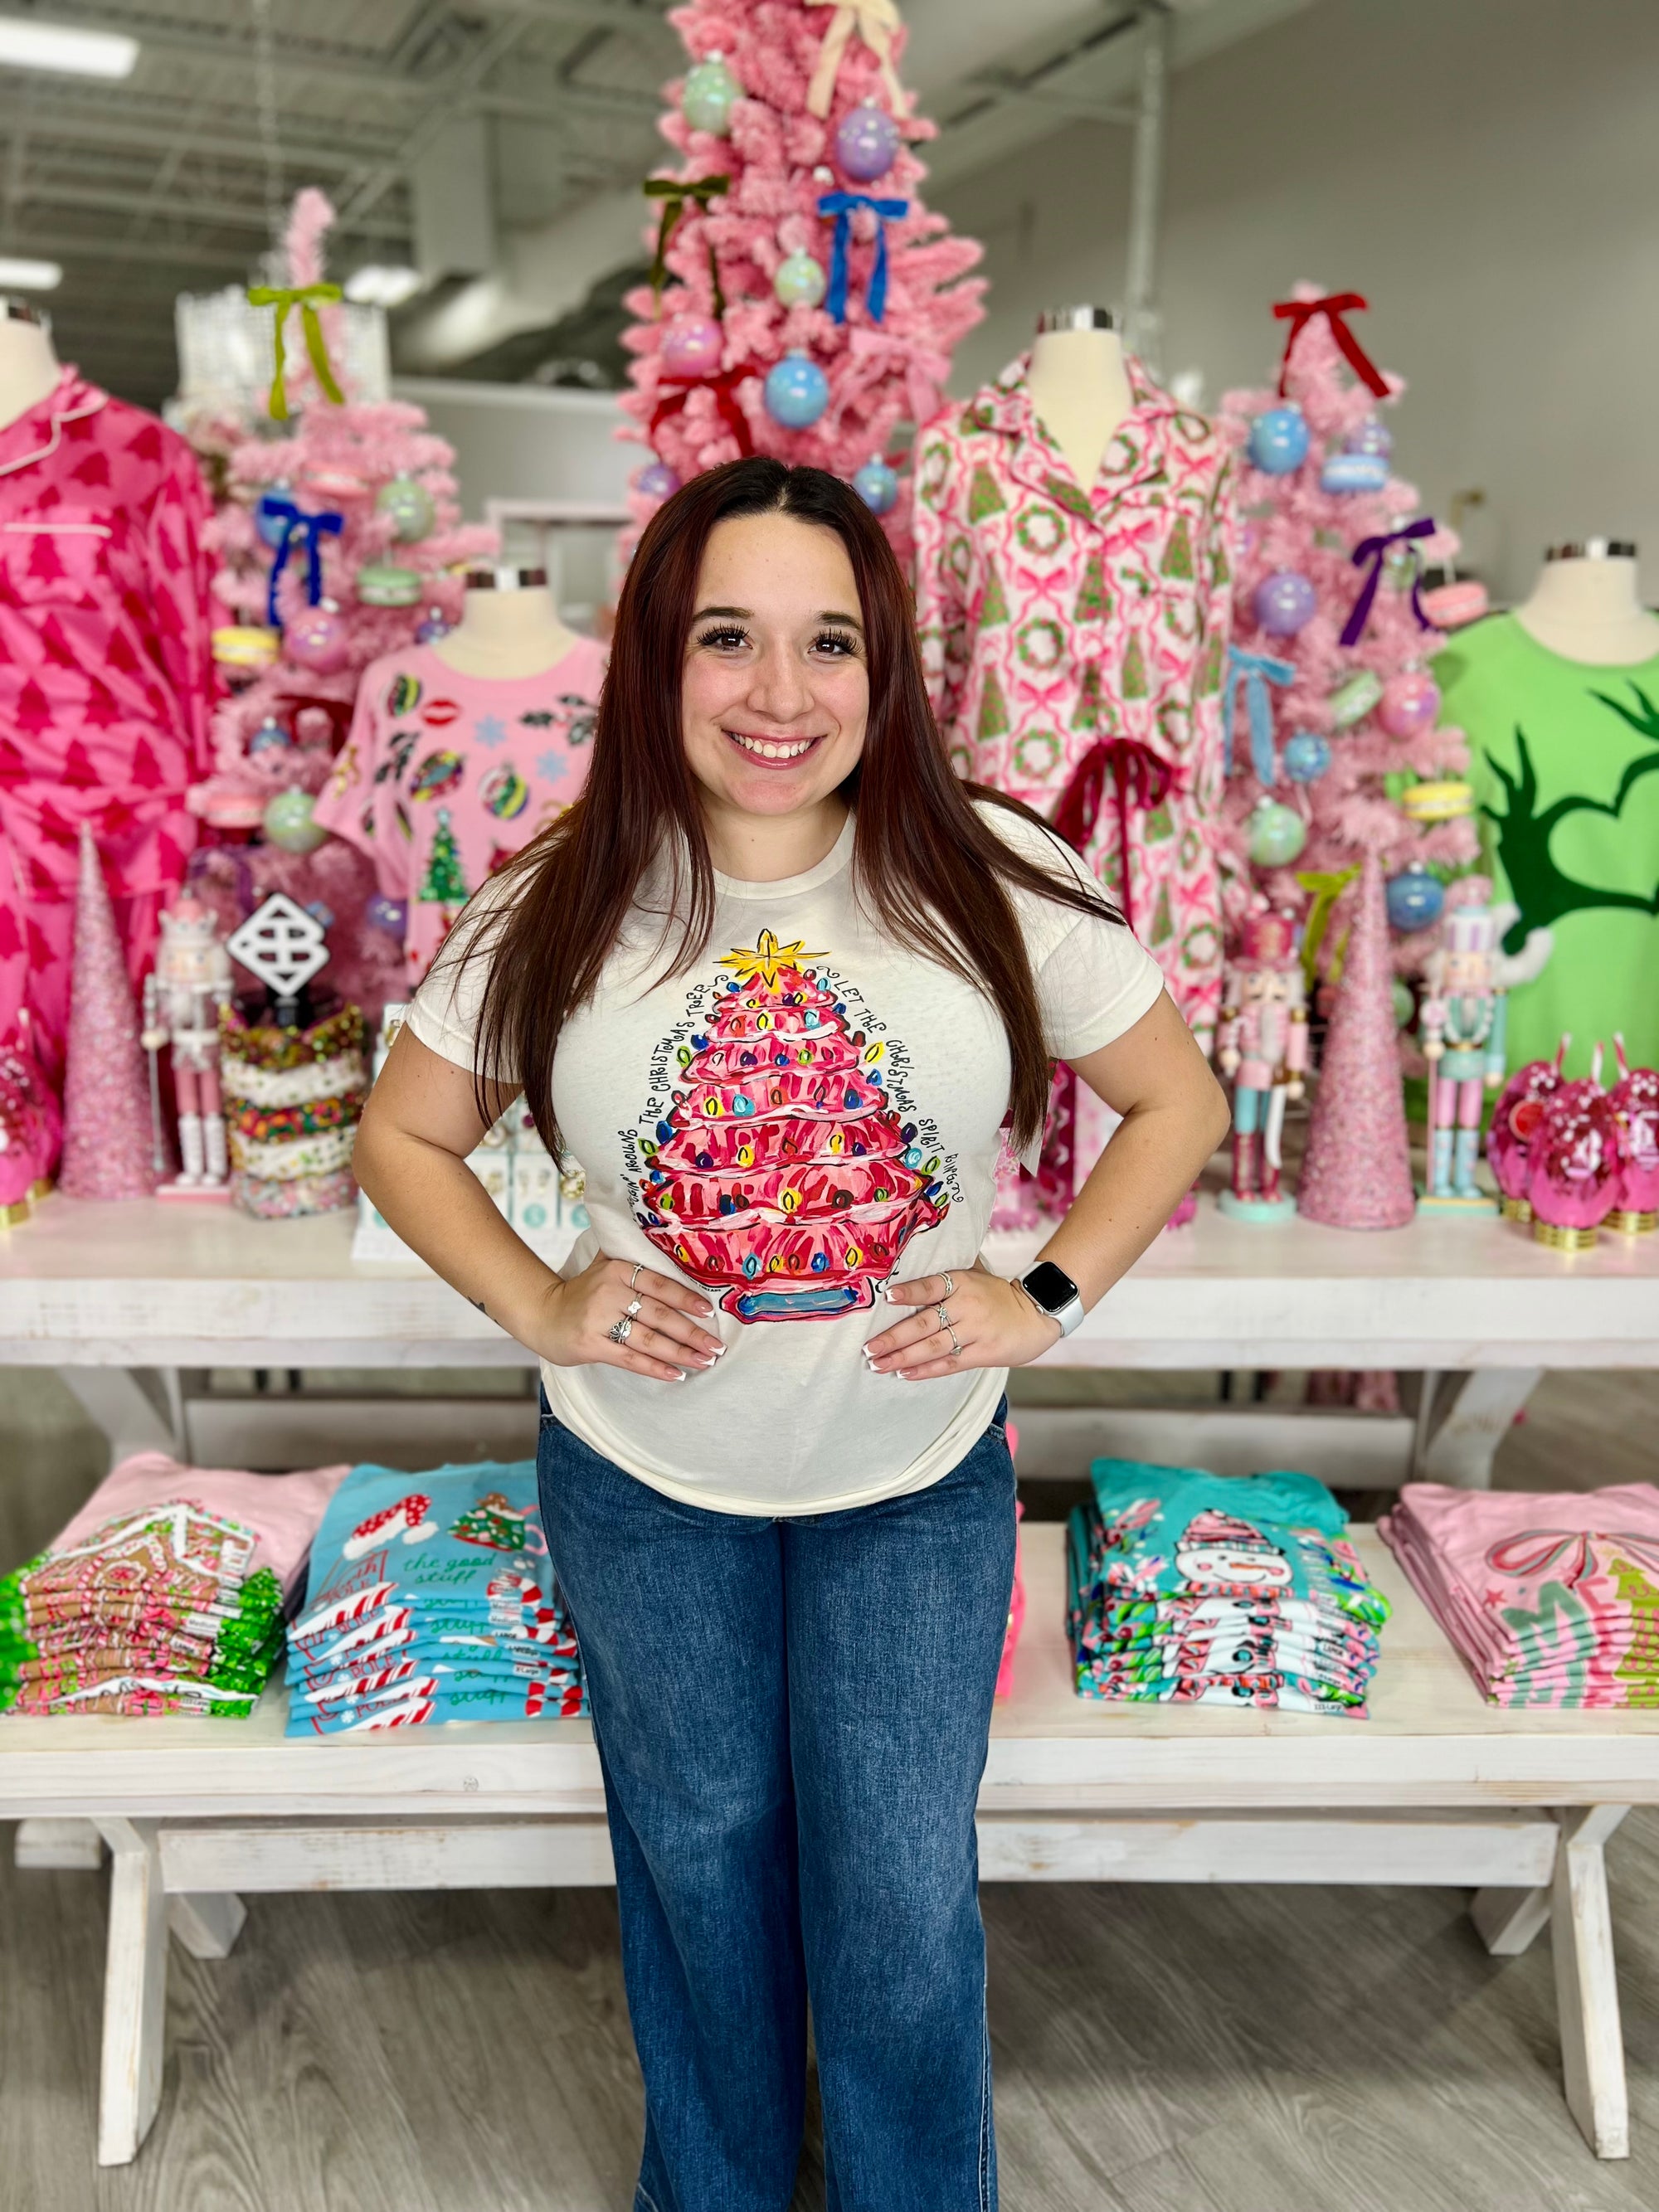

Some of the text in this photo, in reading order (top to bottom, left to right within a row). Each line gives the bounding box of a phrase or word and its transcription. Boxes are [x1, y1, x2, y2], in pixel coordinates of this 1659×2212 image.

[686, 984, 711, 1017] TREE
[648, 1021, 695, 1092] CHRISTMAS
[833, 980, 959, 1185] LET THE CHRISTMAS SPIRIT RING
[639, 1096, 664, 1125] THE
[617, 1128, 643, 1174] AROUND
[403, 1552, 497, 1573] the good
[415, 1569, 477, 1585] stuff
[350, 1654, 397, 1679] POLE
